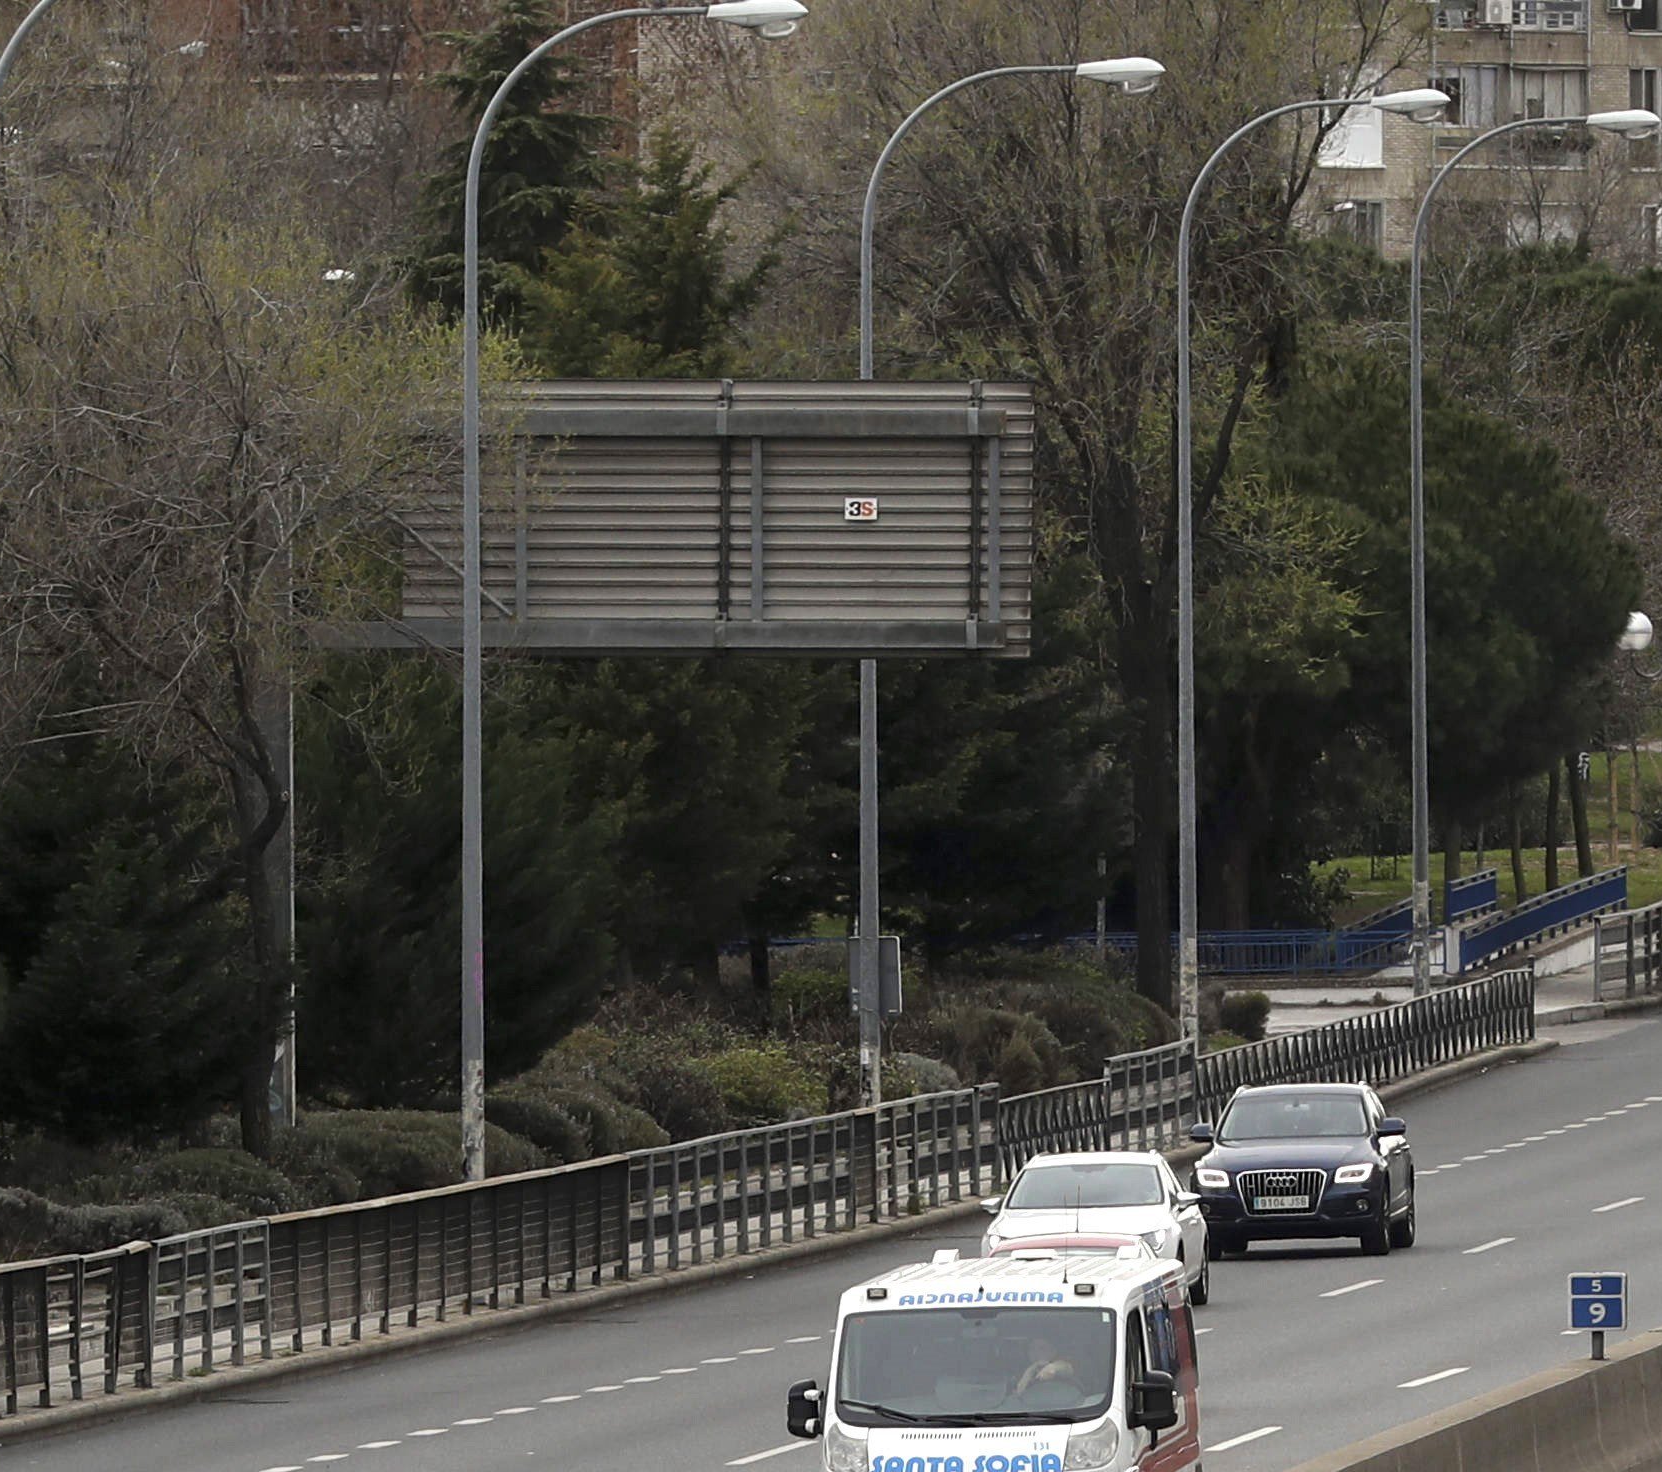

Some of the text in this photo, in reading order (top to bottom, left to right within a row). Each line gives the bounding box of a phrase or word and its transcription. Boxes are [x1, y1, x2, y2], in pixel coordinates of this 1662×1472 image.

[849, 501, 874, 516] 3S
[1591, 1279, 1602, 1293] 5
[1589, 1302, 1606, 1324] 9
